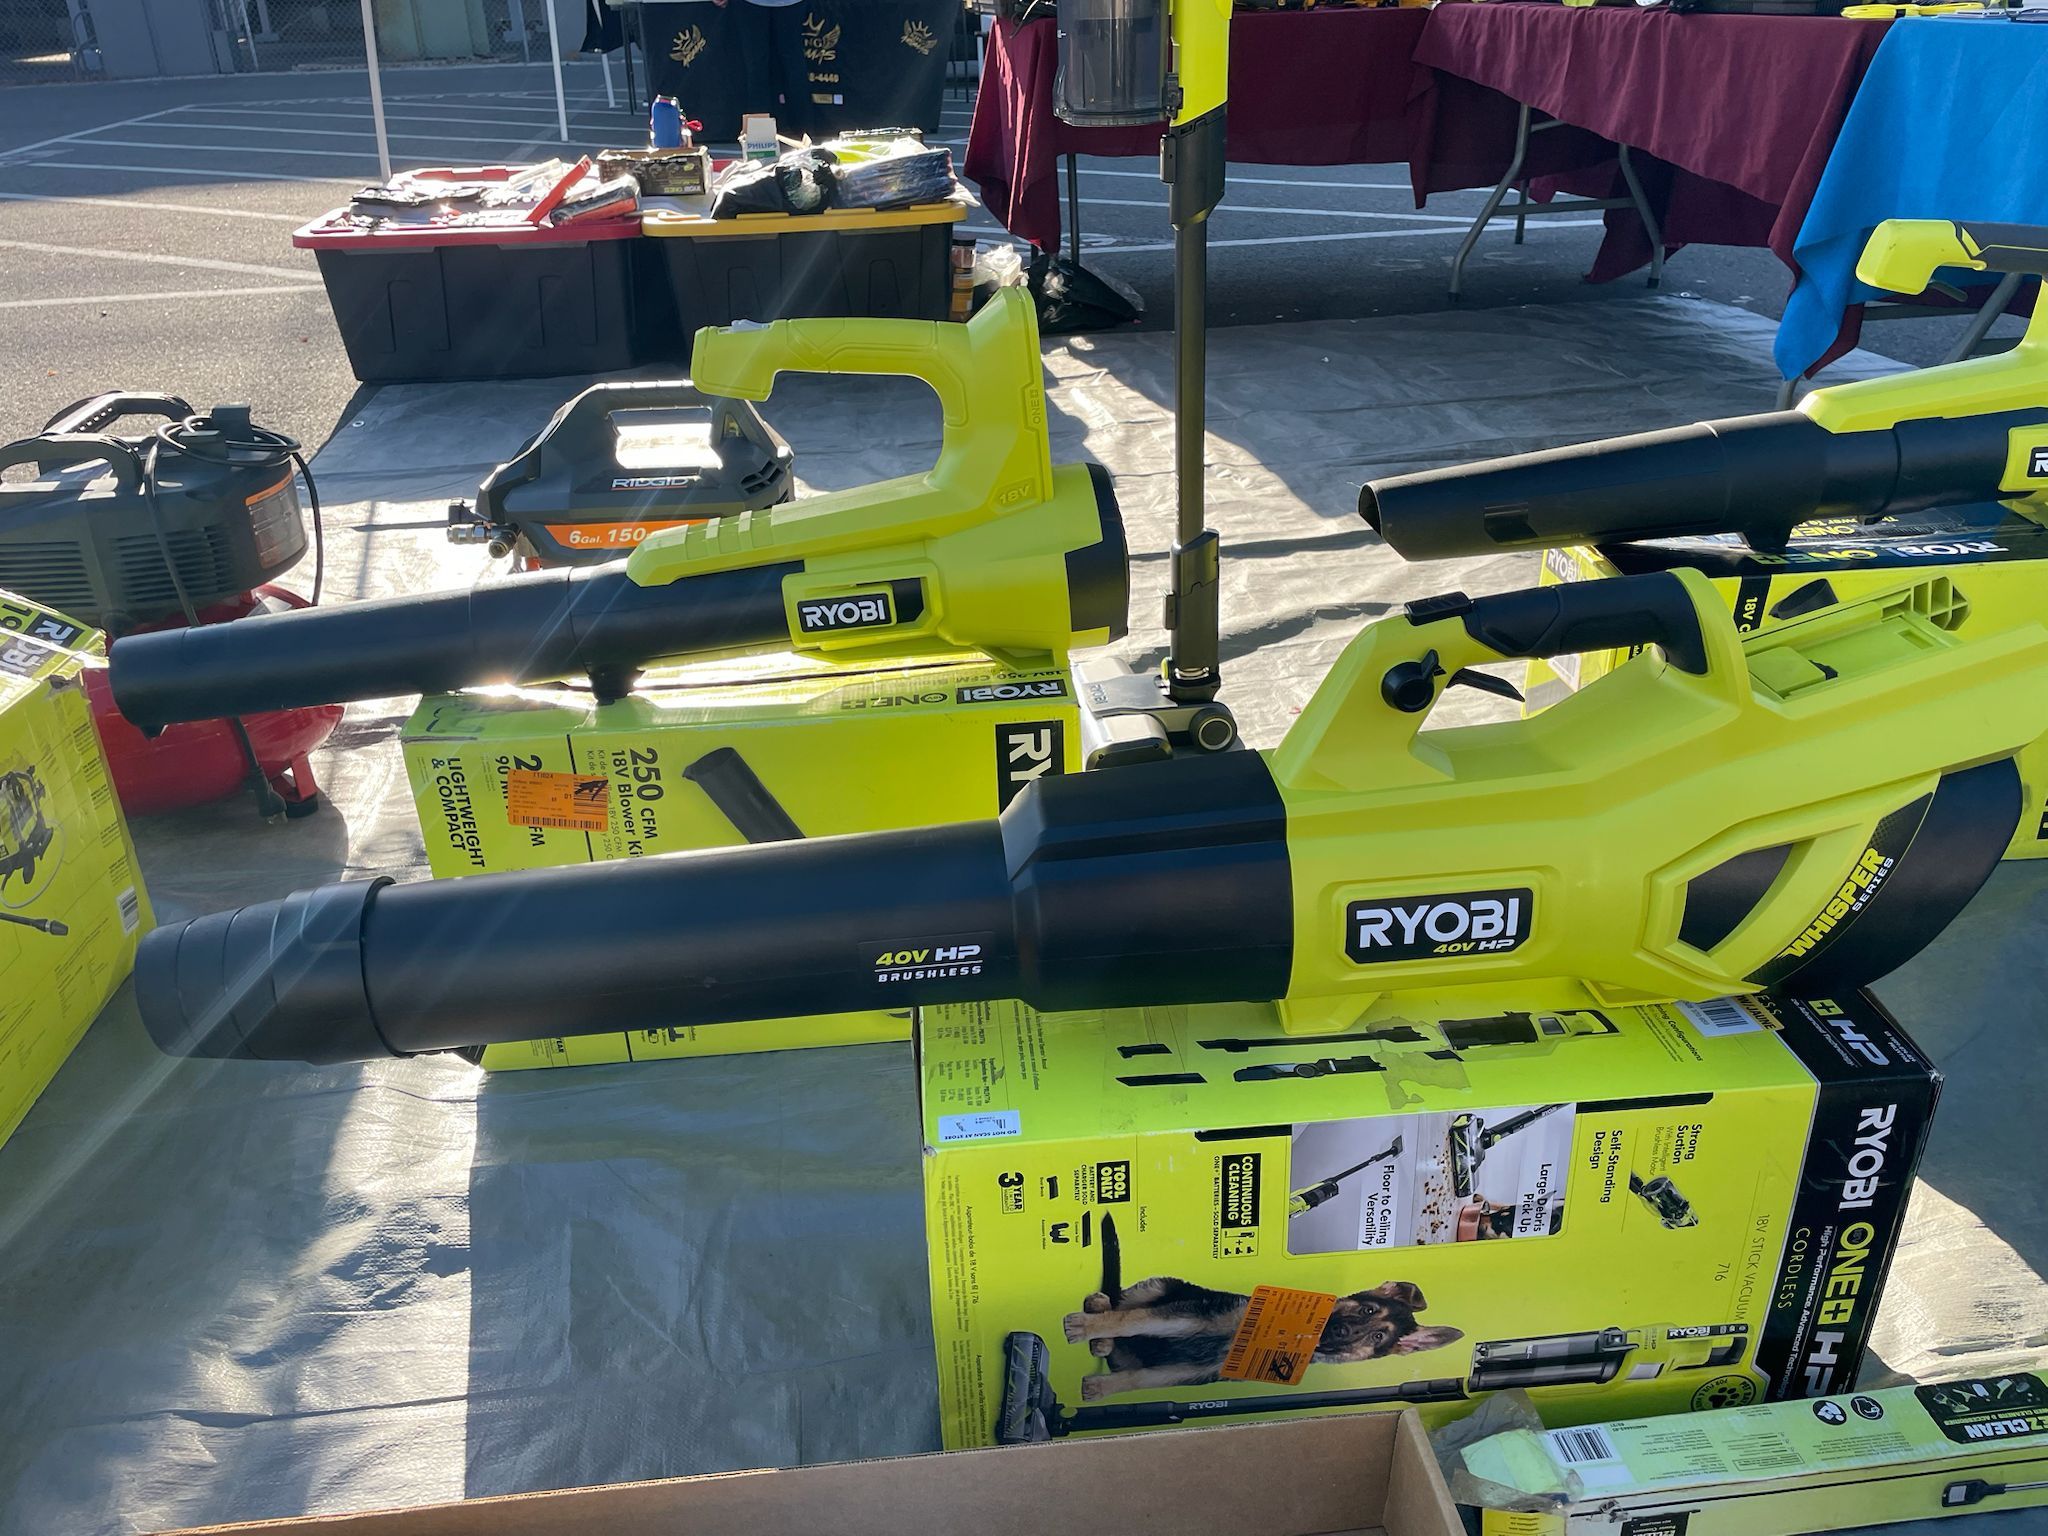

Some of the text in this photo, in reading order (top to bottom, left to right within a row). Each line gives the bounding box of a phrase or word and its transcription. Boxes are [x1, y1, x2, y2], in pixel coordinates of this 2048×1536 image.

[747, 142, 777, 150] PHILIPS
[611, 476, 689, 489] RIDGID
[999, 484, 1032, 505] 18V
[1887, 541, 2009, 559] RYOBI
[801, 598, 886, 629] RYOBI
[1743, 596, 1758, 621] 18V
[963, 681, 1062, 702] RYOBI
[431, 758, 466, 851] & COMPACT
[446, 757, 486, 868] LIGHTWEIGHT
[611, 750, 643, 858] 18V Blower Ki
[630, 747, 664, 840] 250 CFM
[529, 826, 546, 847] FM
[610, 821, 619, 835] 250
[1776, 847, 1887, 960] WHISPER
[1852, 857, 1894, 912] SERIES
[1356, 897, 1520, 949] RYOBI
[875, 944, 982, 967] 40V HP
[1432, 938, 1516, 954] 40V HP
[878, 965, 982, 983] BRUSHLESS
[1827, 1019, 1890, 1066] HP
[1589, 1131, 1606, 1170] Design
[1672, 1125, 1689, 1164] Suction
[1684, 1123, 1703, 1161] Strong
[998, 1171, 1025, 1188] 3
[1100, 1166, 1113, 1200] ONLY
[1113, 1164, 1126, 1199] TOOL
[1600, 1129, 1623, 1204] Self-Standing
[1013, 1186, 1023, 1210] YEAR
[1228, 1162, 1240, 1221] CLEANING
[1240, 1155, 1254, 1226] CONTINUOUS
[1376, 1165, 1395, 1245] Floor to Ceiling
[1532, 1163, 1552, 1232] Large Debris
[1139, 1205, 1147, 1233] Includes
[1361, 1192, 1379, 1246] Versatility
[1517, 1193, 1534, 1233] Pick Up
[1803, 1103, 1898, 1399] RYOBI ONE+ HP
[1818, 1225, 1834, 1249] High
[1713, 1262, 1731, 1282] 716
[1735, 1213, 1770, 1321] 18V STICK VACUUM
[1777, 1227, 1811, 1309] CORDLESS
[1668, 1326, 1711, 1337] RYOBI
[1791, 1309, 1812, 1353] Advanced
[1188, 1400, 1229, 1410] RYOBI
